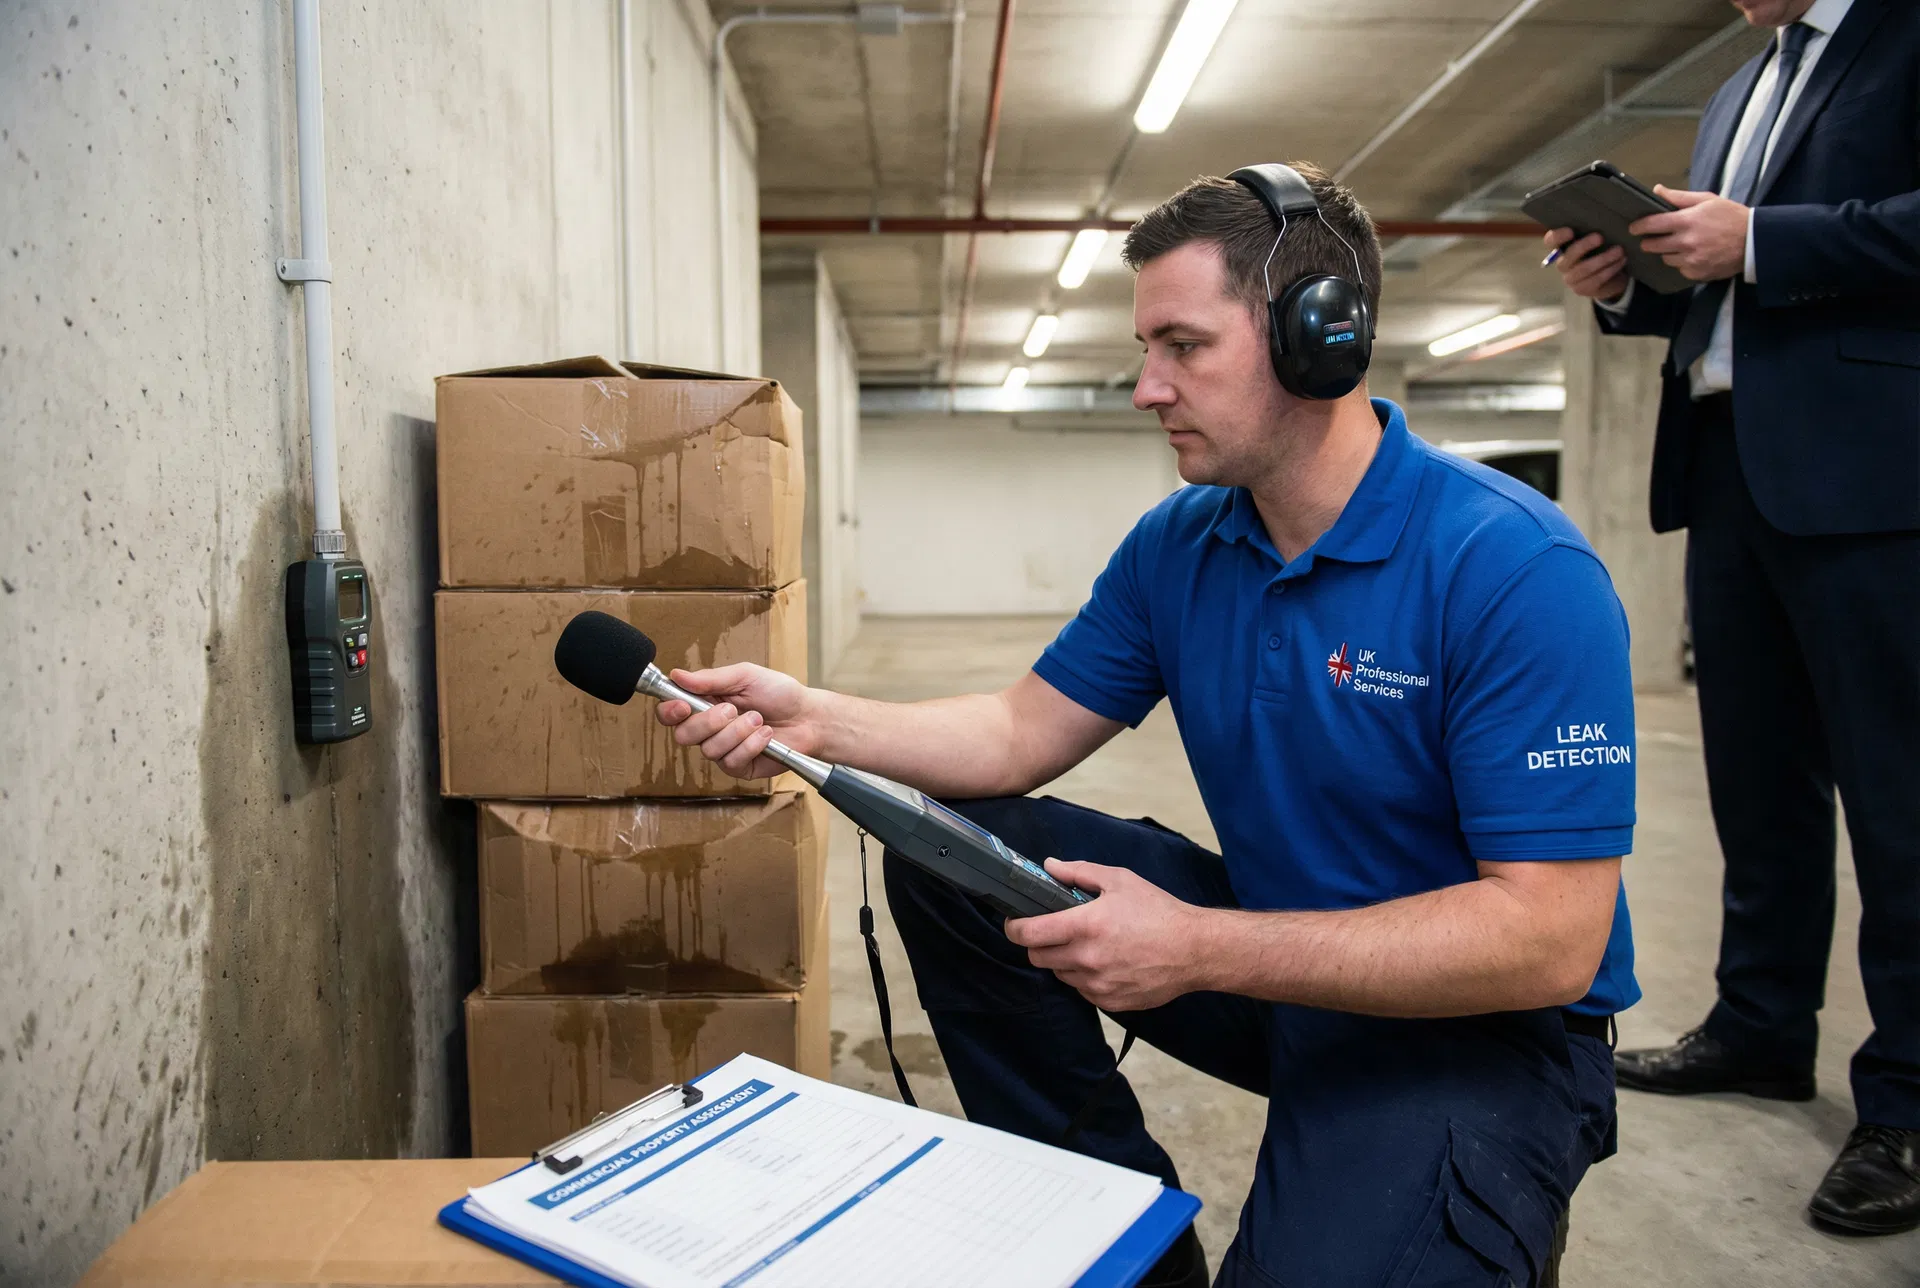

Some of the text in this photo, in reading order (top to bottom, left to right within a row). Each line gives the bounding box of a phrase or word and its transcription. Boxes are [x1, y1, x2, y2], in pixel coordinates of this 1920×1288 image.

[1358, 649, 1376, 663] UK
[1355, 664, 1430, 687] Professional
[1353, 679, 1404, 699] Services
[1556, 723, 1608, 744] LEAK
[1527, 745, 1631, 770] DETECTION
[546, 1156, 634, 1202] COMMERCIAL
[630, 1122, 690, 1158] PROPERTY
[689, 1085, 758, 1127] ASSESSMENT
